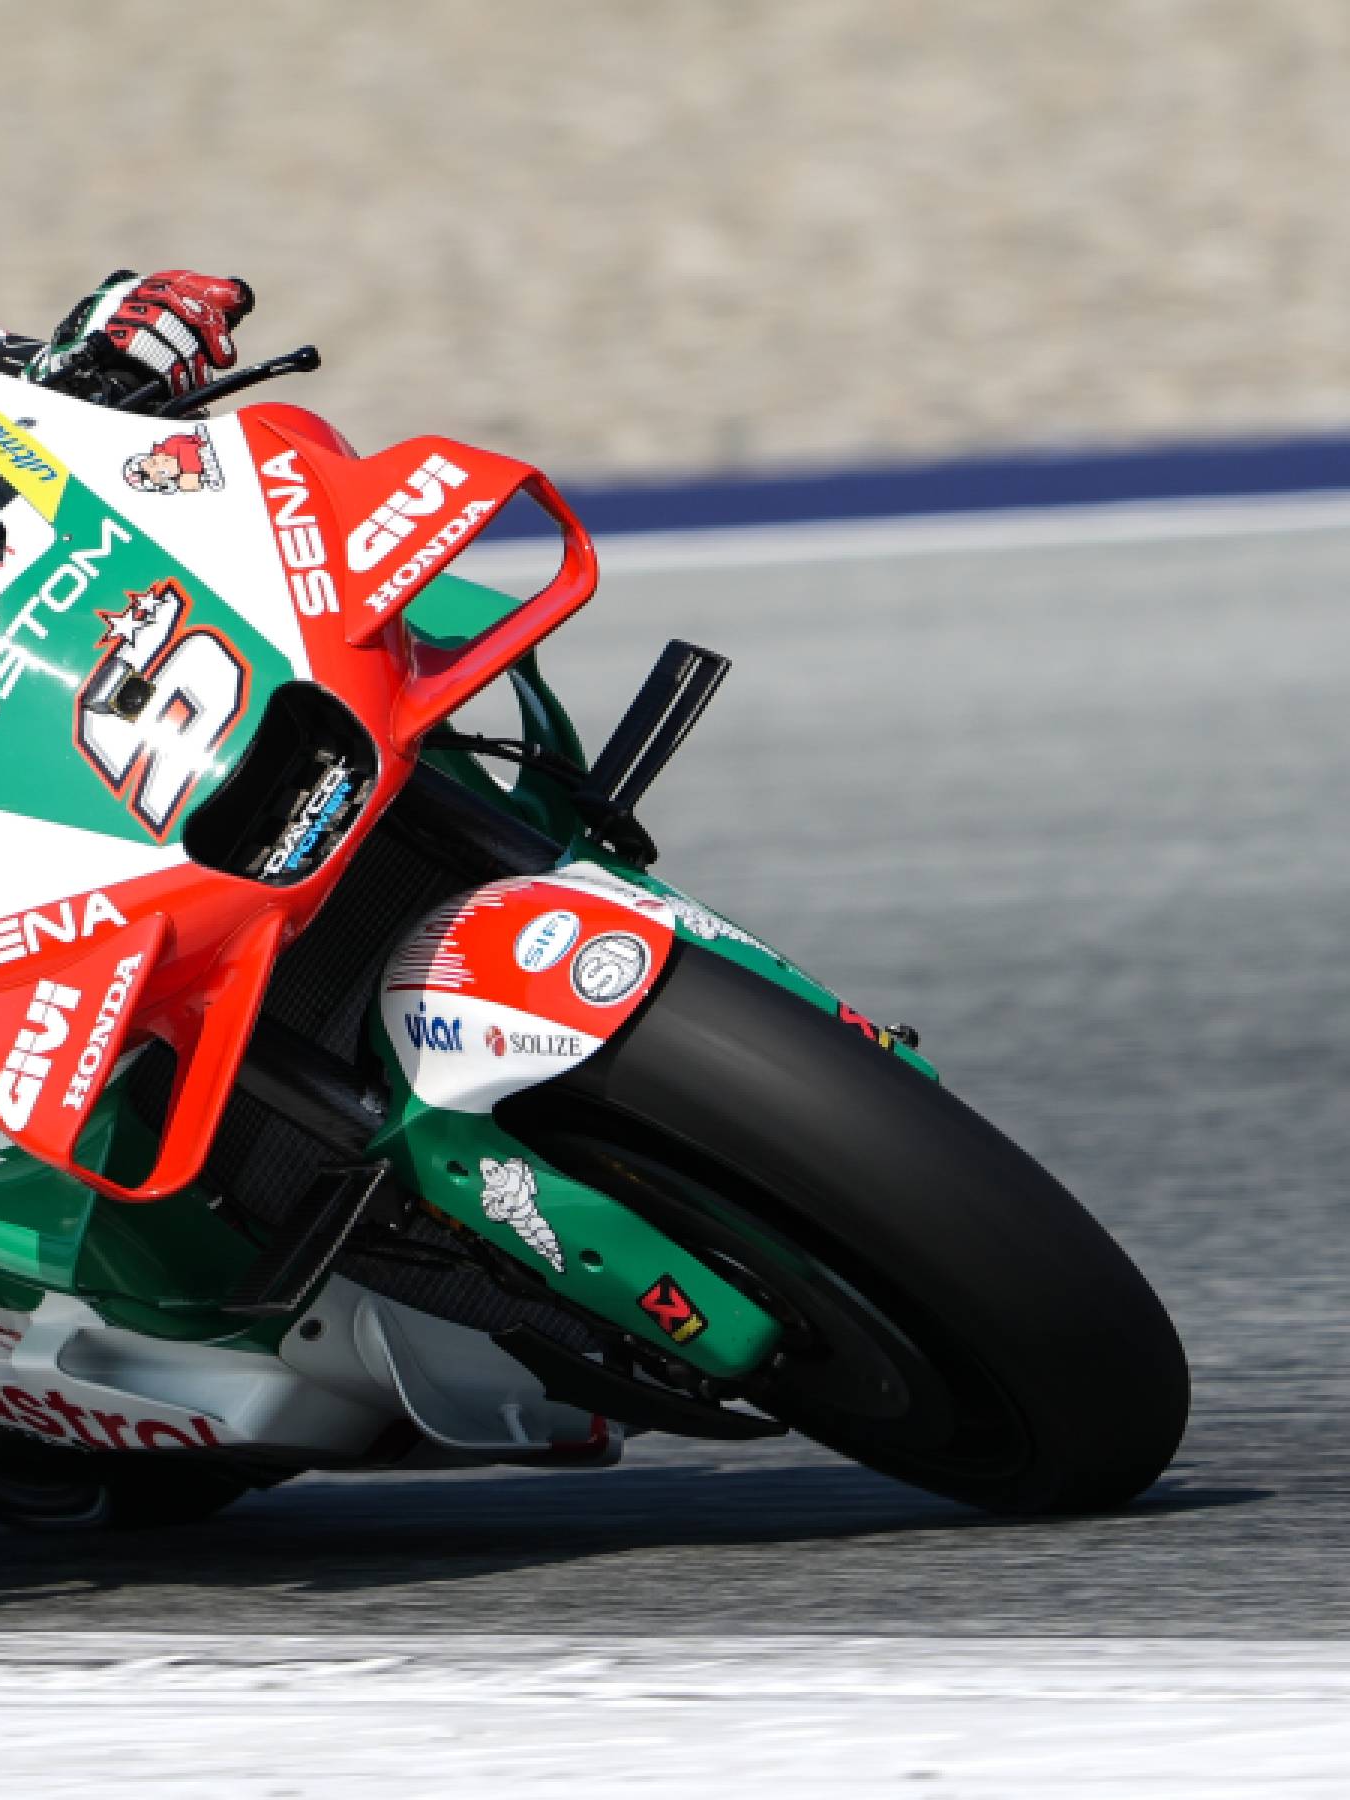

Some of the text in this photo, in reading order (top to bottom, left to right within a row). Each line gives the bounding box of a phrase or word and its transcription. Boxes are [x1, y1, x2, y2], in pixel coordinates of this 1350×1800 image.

[261, 448, 340, 617] SENA
[346, 452, 469, 573] GIVI
[363, 499, 496, 613] HONDA
[262, 762, 348, 877] DAYCO
[61, 951, 144, 1111] HONDA
[509, 1032, 583, 1057] SOLIZE
